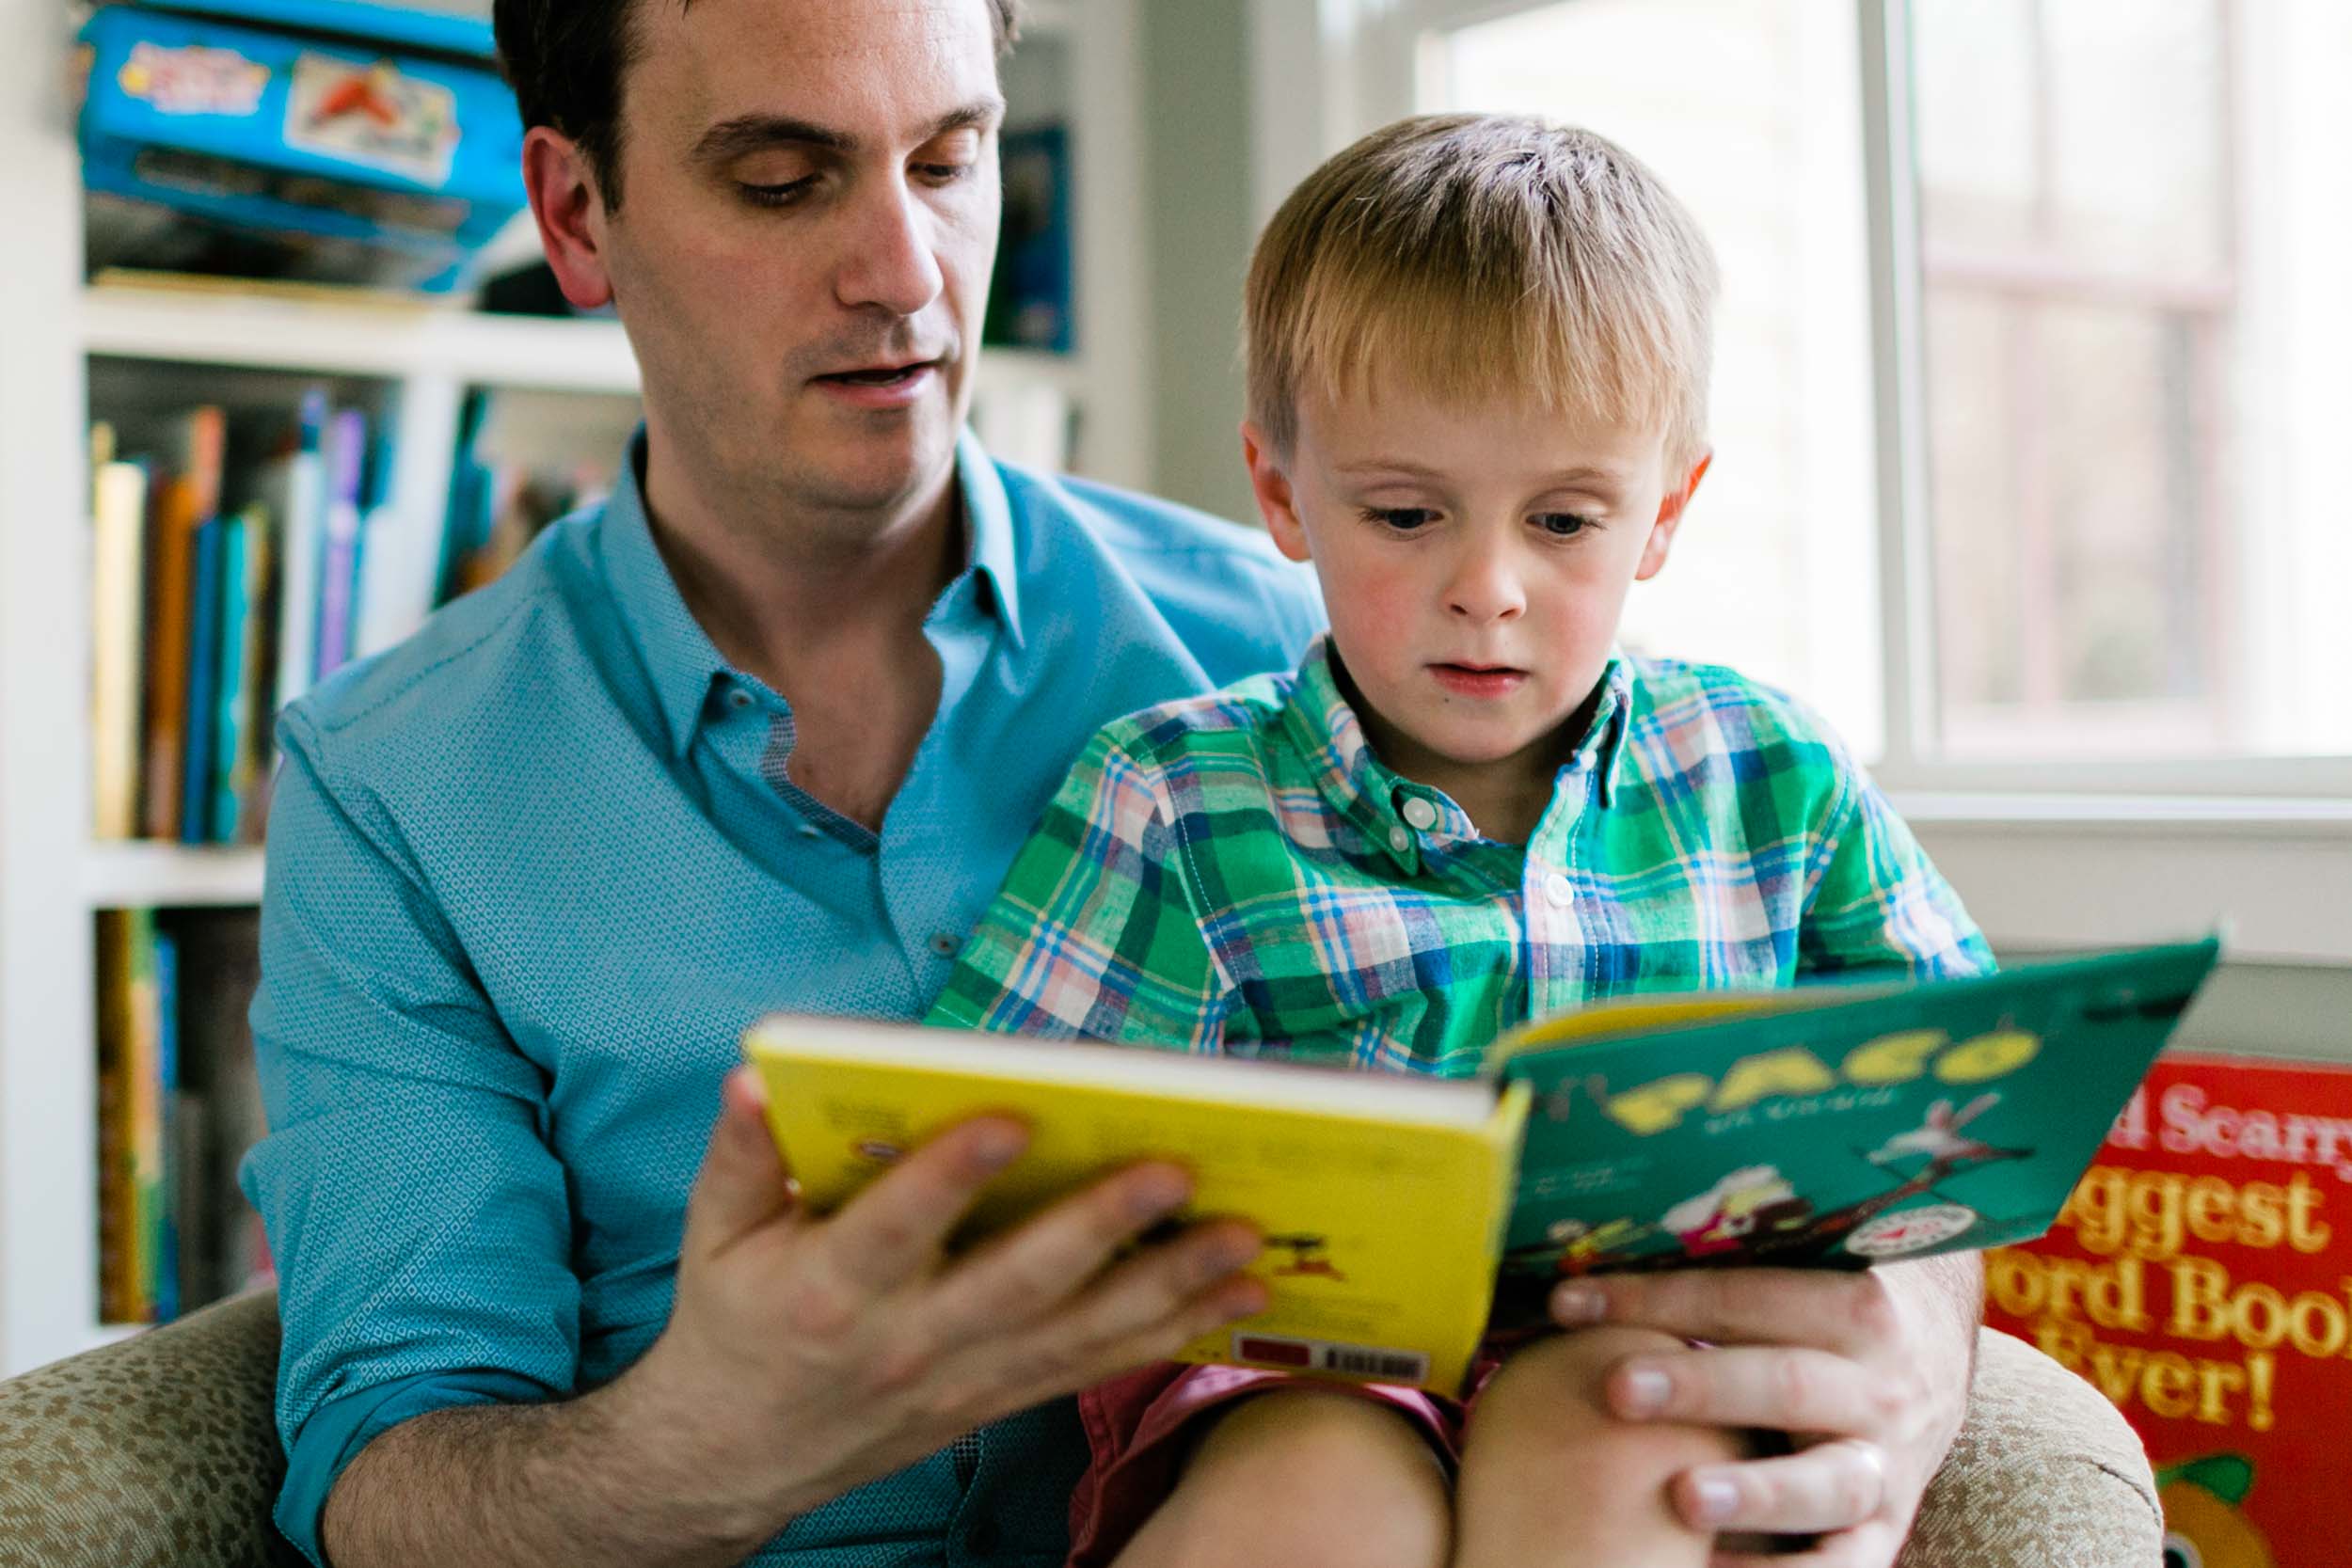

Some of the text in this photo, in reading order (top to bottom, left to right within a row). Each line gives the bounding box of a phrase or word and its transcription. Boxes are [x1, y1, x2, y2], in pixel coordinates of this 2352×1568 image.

[1602, 1028, 2041, 1135] PACO
[2058, 1164, 2333, 1262] ggest
[1983, 1247, 2352, 1358] ord Boo
